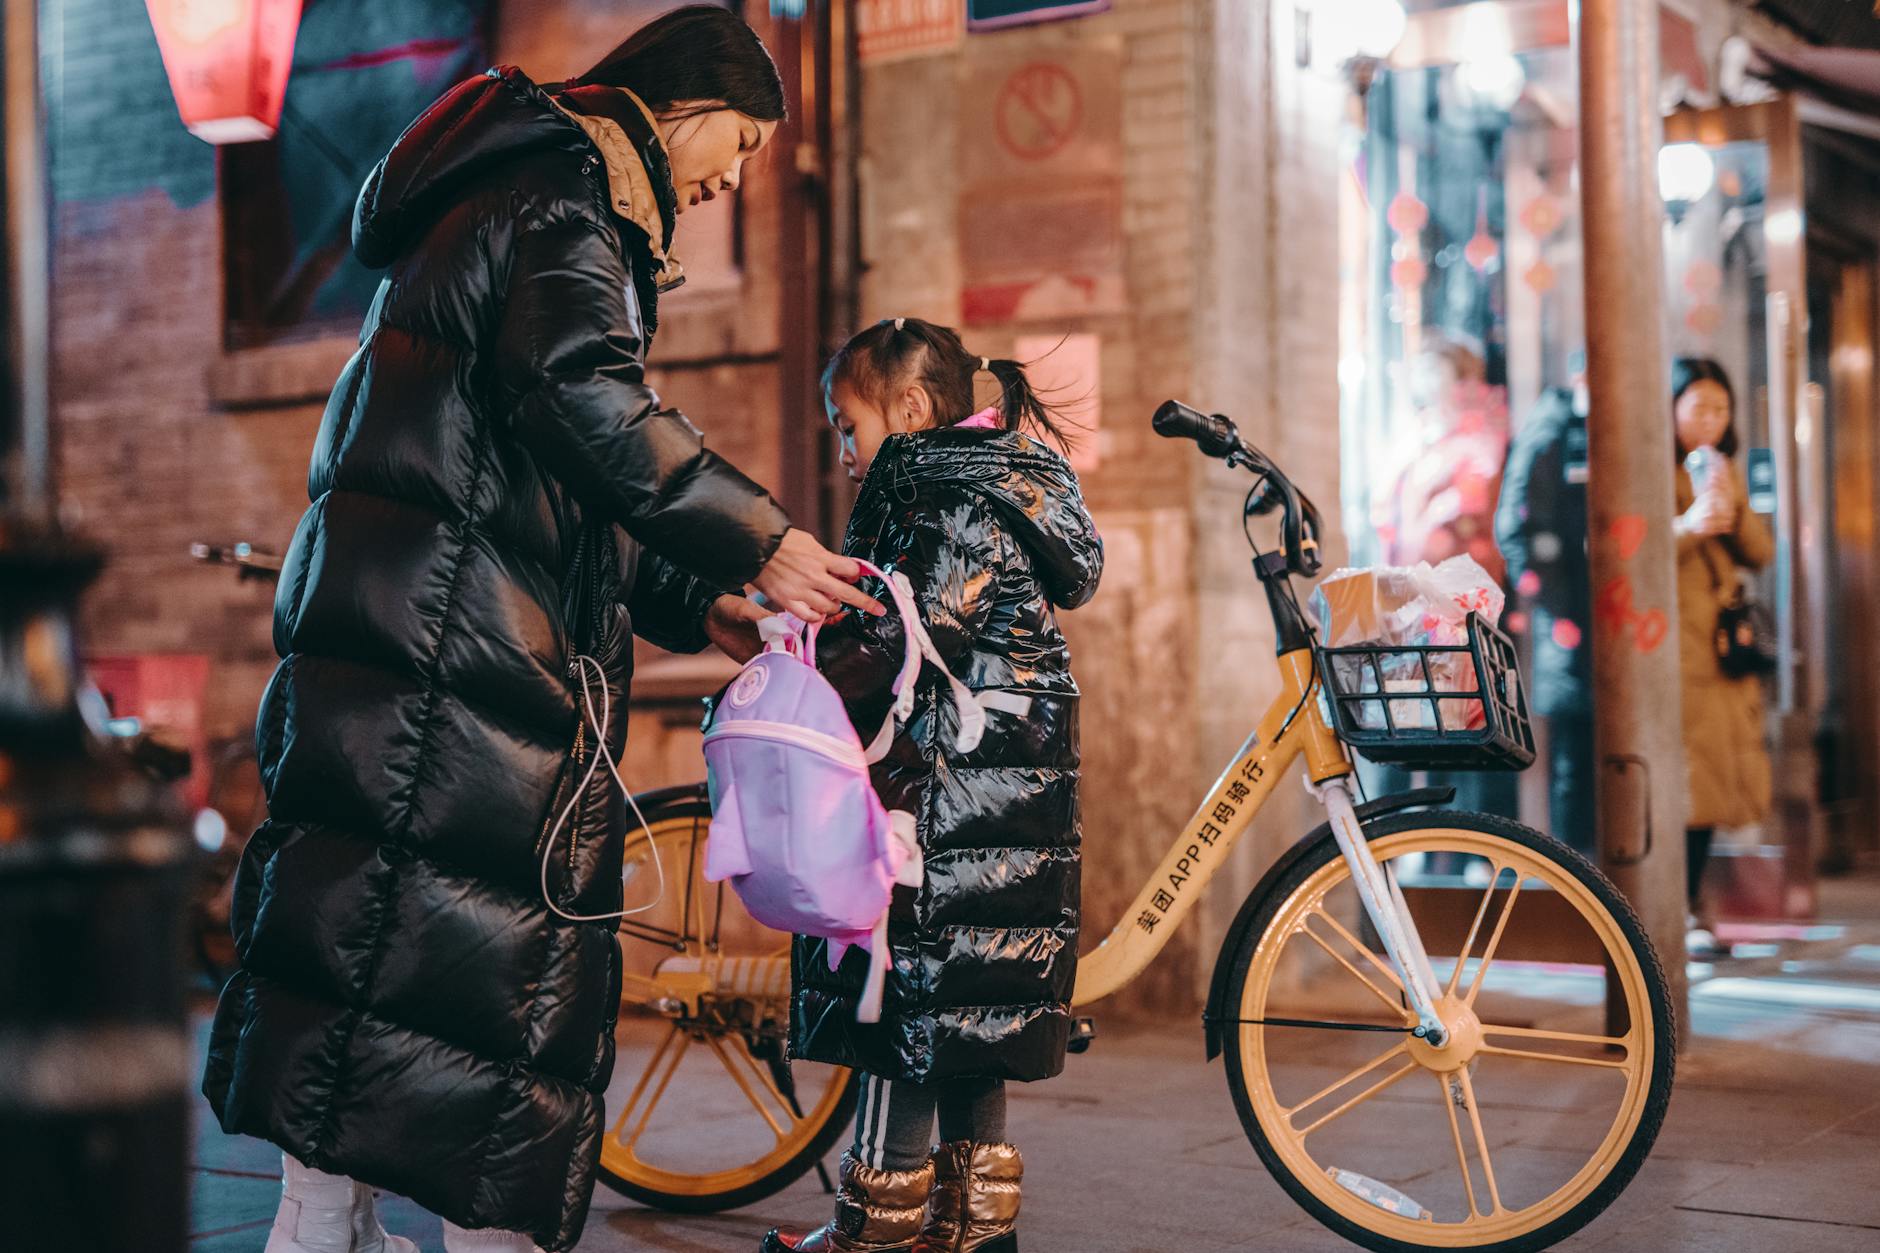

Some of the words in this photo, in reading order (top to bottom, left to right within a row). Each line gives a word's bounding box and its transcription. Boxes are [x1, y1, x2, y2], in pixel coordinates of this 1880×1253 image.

[569, 828, 578, 868] FASHION
[1136, 758, 1264, 935] 美团APP扫码骑行
